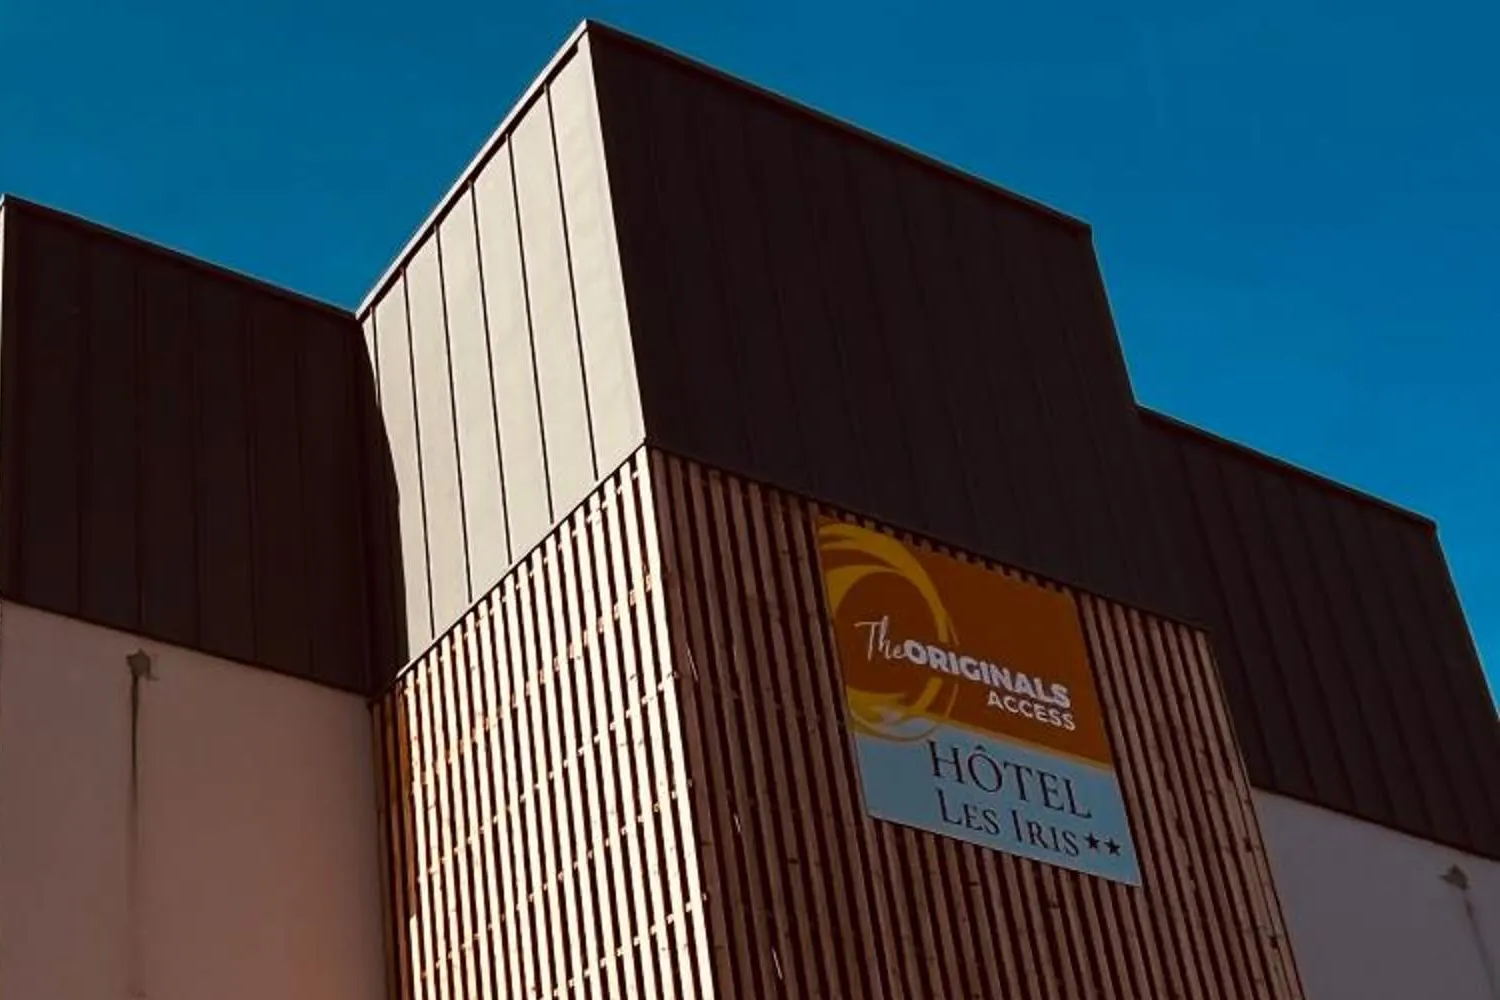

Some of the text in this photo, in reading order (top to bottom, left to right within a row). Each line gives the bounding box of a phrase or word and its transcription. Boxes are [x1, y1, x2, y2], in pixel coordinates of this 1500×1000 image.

[854, 615, 1071, 709] The ORIGINALS
[987, 690, 1076, 732] ACCESS
[926, 739, 1093, 819] HÔTEL
